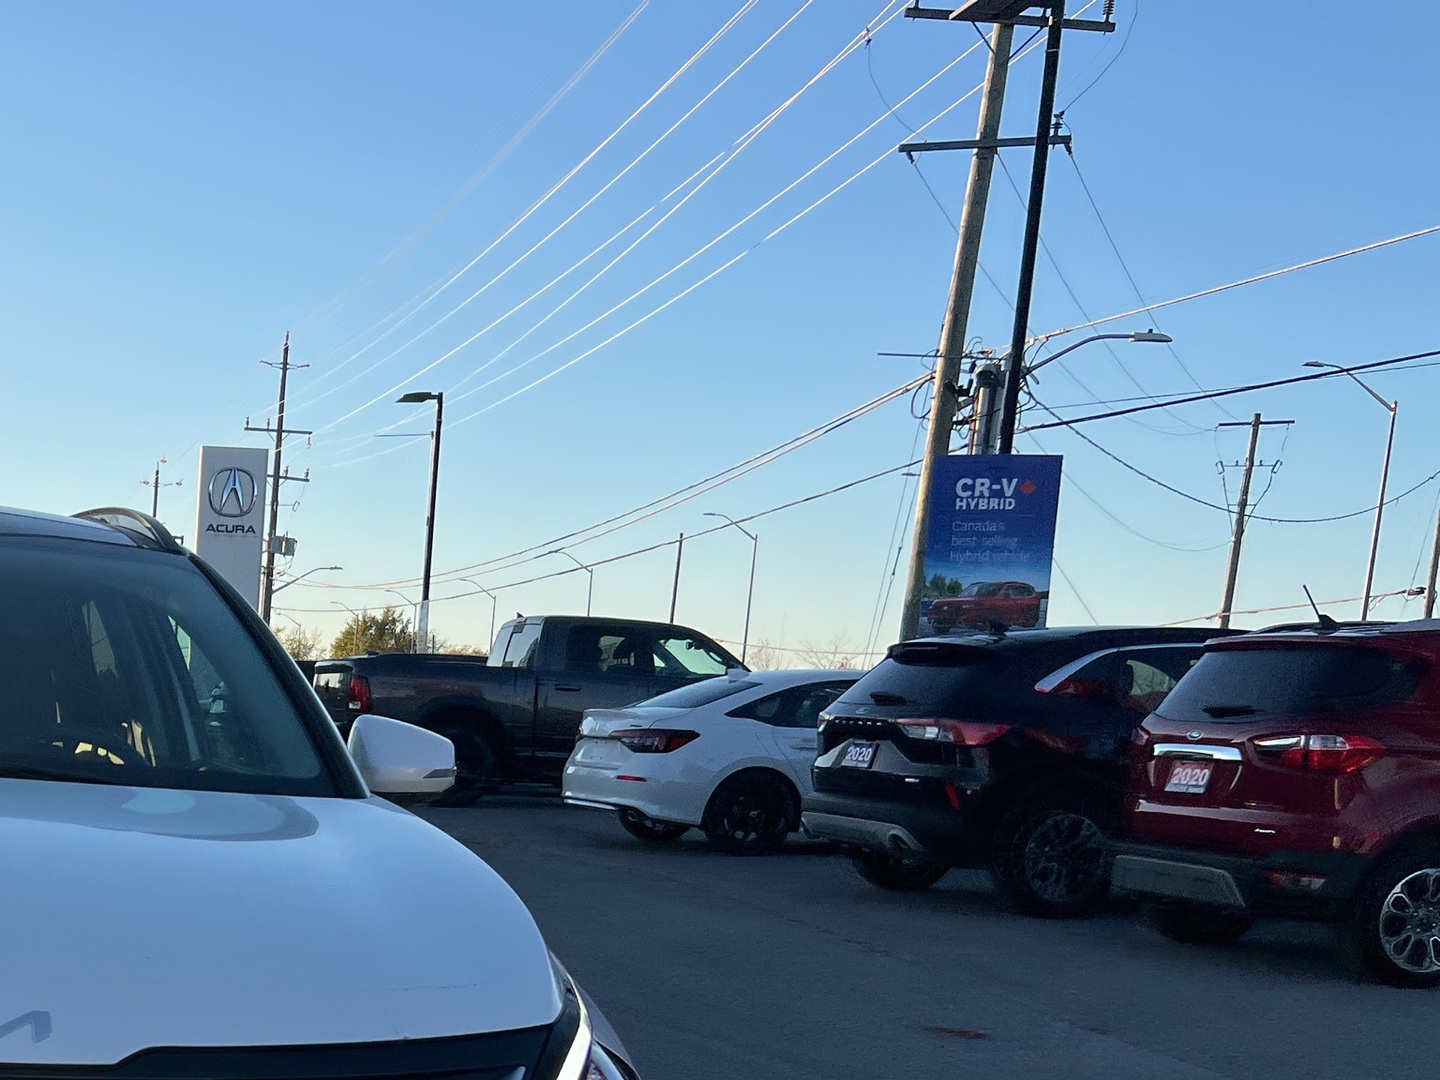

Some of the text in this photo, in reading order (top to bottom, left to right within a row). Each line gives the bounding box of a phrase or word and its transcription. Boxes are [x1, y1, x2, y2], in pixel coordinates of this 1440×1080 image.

[955, 477, 1018, 498] CR-V
[955, 498, 1016, 510] HYBRID
[205, 523, 256, 534] ACURA
[844, 746, 873, 761] 2020
[1170, 767, 1211, 786] 2020
